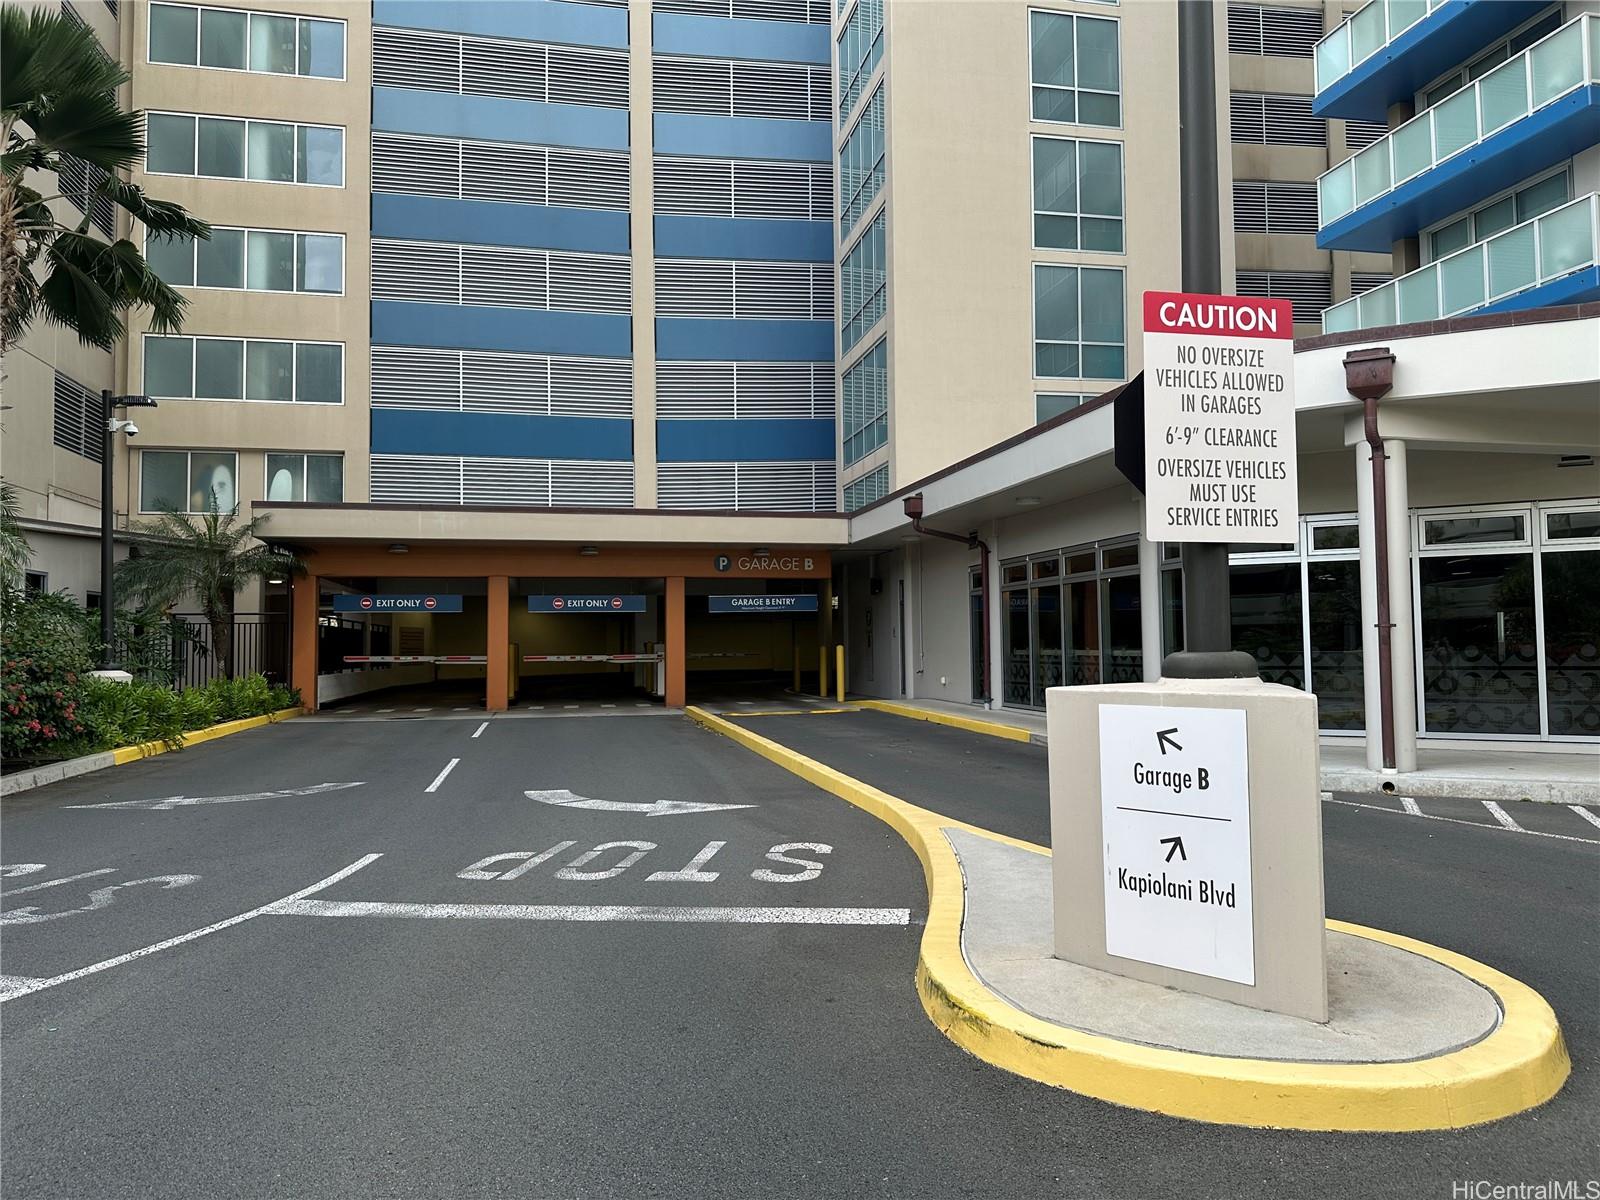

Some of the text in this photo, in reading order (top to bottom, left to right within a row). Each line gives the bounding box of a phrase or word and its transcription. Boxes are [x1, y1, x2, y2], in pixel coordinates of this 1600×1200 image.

[1159, 302, 1277, 332] CAUTION
[1177, 345, 1264, 367] NO OVERSIZE
[1156, 369, 1284, 392] VEHICLES ALLOWED
[1182, 395, 1261, 415] IN GARAGES
[1204, 428, 1277, 447] CLEARANCE
[1157, 459, 1286, 479] OVERSIZE VEHICLES
[1190, 484, 1256, 502] MUST USE
[1167, 508, 1279, 527] SERVICE ENTRIES
[738, 557, 800, 571] GARAGE
[804, 558, 814, 571] B
[376, 599, 421, 608] EXIT ONLY
[567, 599, 608, 608] EXIT ONLY
[731, 598, 764, 606] GARAGE
[1134, 763, 1209, 793] Garage B
[456, 840, 834, 883] STOP
[1118, 868, 1235, 908] Kapiolani Blvd
